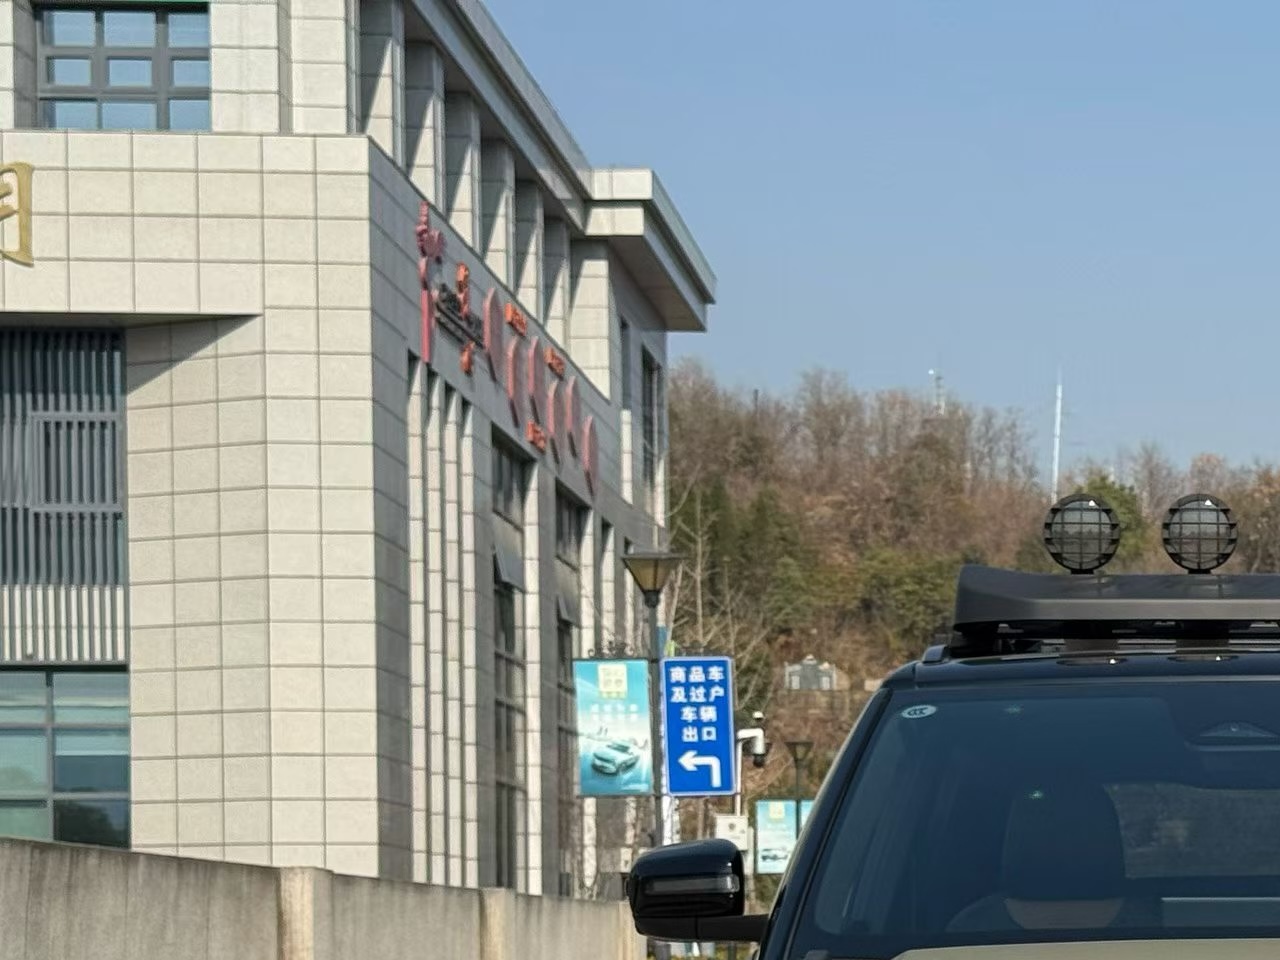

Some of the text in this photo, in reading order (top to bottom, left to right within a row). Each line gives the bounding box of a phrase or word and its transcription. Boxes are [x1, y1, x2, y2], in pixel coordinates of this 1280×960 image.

[669, 665, 725, 683] 商品车
[670, 685, 725, 703] 及过户
[680, 705, 718, 723] 车辆
[682, 725, 717, 742] 出口
